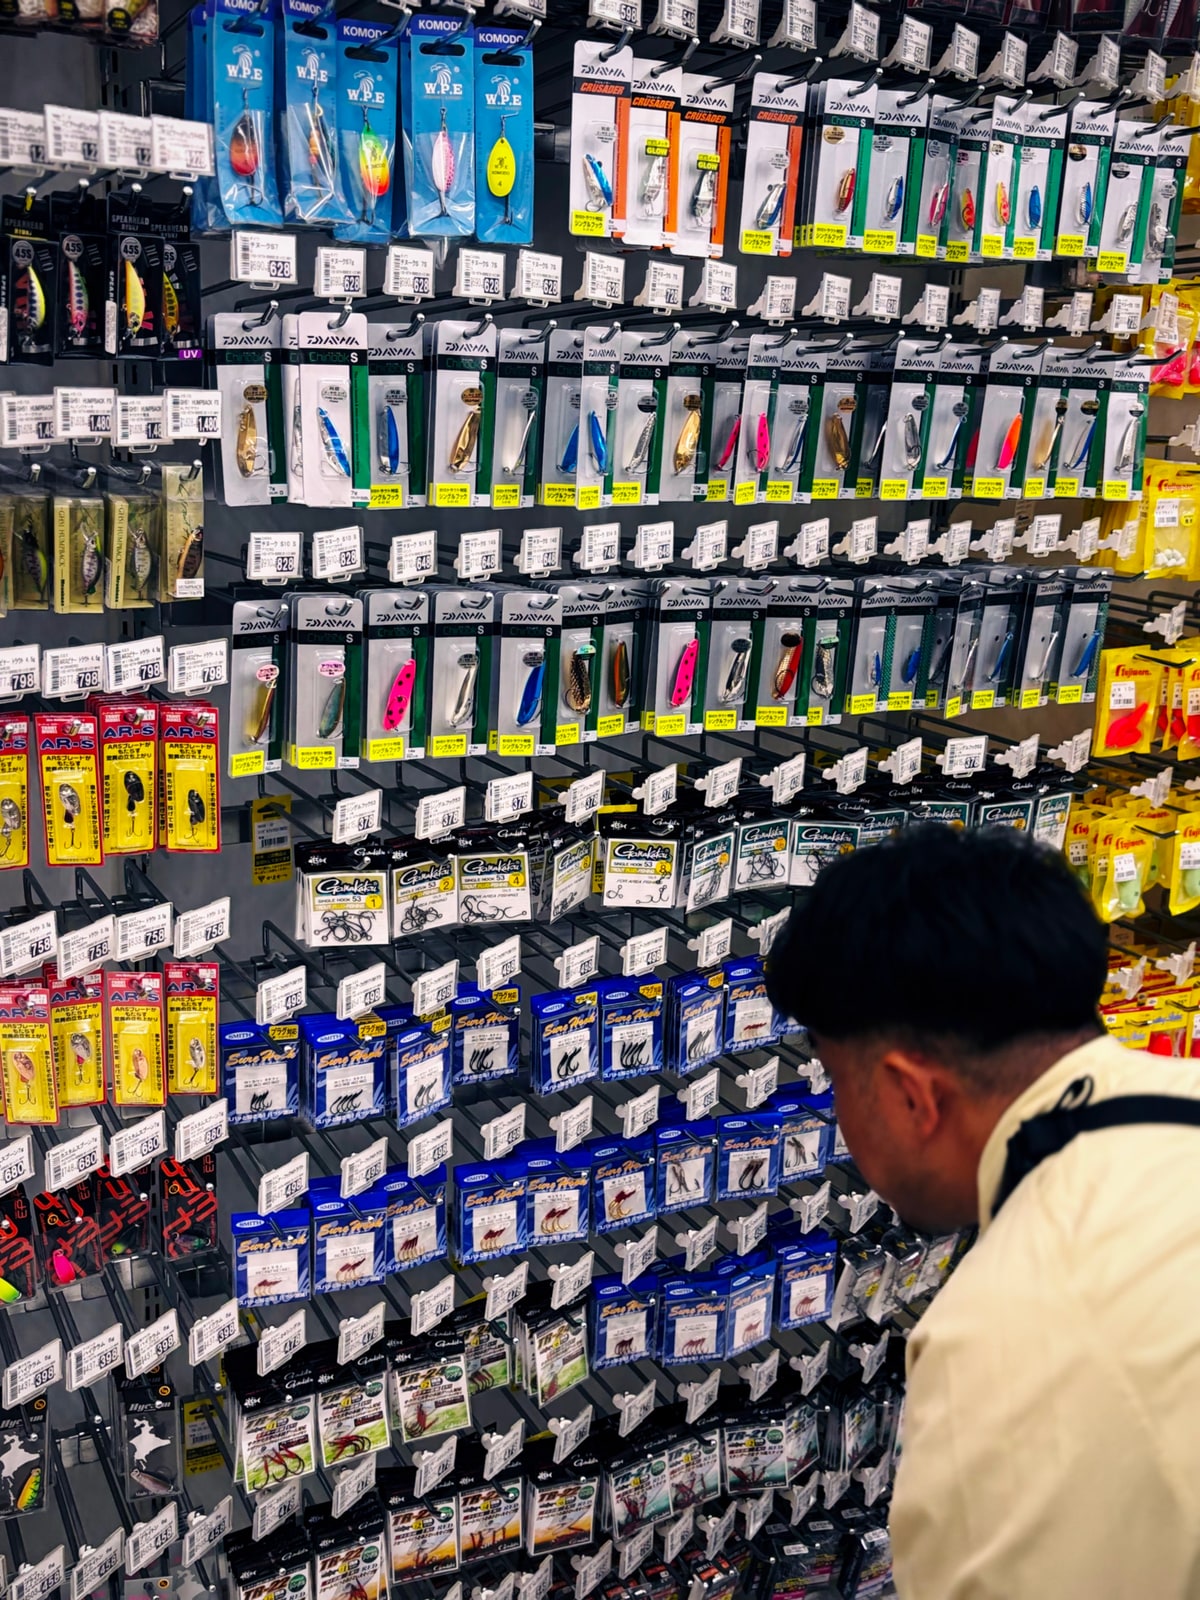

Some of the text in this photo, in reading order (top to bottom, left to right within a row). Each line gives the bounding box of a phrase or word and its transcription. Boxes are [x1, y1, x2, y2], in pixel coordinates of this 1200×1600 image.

[620, 6, 638, 21] 598
[424, 82, 462, 95] W.P.E
[580, 82, 624, 95] CRUSADER
[486, 94, 522, 106] W.P.E
[632, 96, 675, 110] CRUSADER
[685, 111, 726, 124] CRUSADER
[757, 112, 798, 124] CRUSADER
[270, 262, 290, 277] 628
[344, 276, 360, 291] 628
[413, 278, 429, 292] 628
[484, 280, 500, 292] 628
[544, 280, 558, 295] 628
[184, 350, 198, 358] UV
[276, 557, 294, 570] 828
[340, 550, 357, 566] 828
[416, 556, 432, 570] 648
[140, 664, 160, 679] 798
[202, 666, 222, 682] 798
[11, 674, 34, 690] 798
[78, 673, 98, 688] 798
[103, 726, 154, 738] AR-S
[40, 738, 94, 750] AR-S
[146, 928, 165, 946] 758
[205, 922, 224, 940] 758
[30, 937, 52, 958] 758
[89, 942, 110, 962] 758
[286, 992, 303, 1010] 498
[204, 1128, 223, 1144] 880
[141, 1136, 160, 1154] 680
[78, 1153, 97, 1172] 680
[4, 1162, 25, 1181] 680
